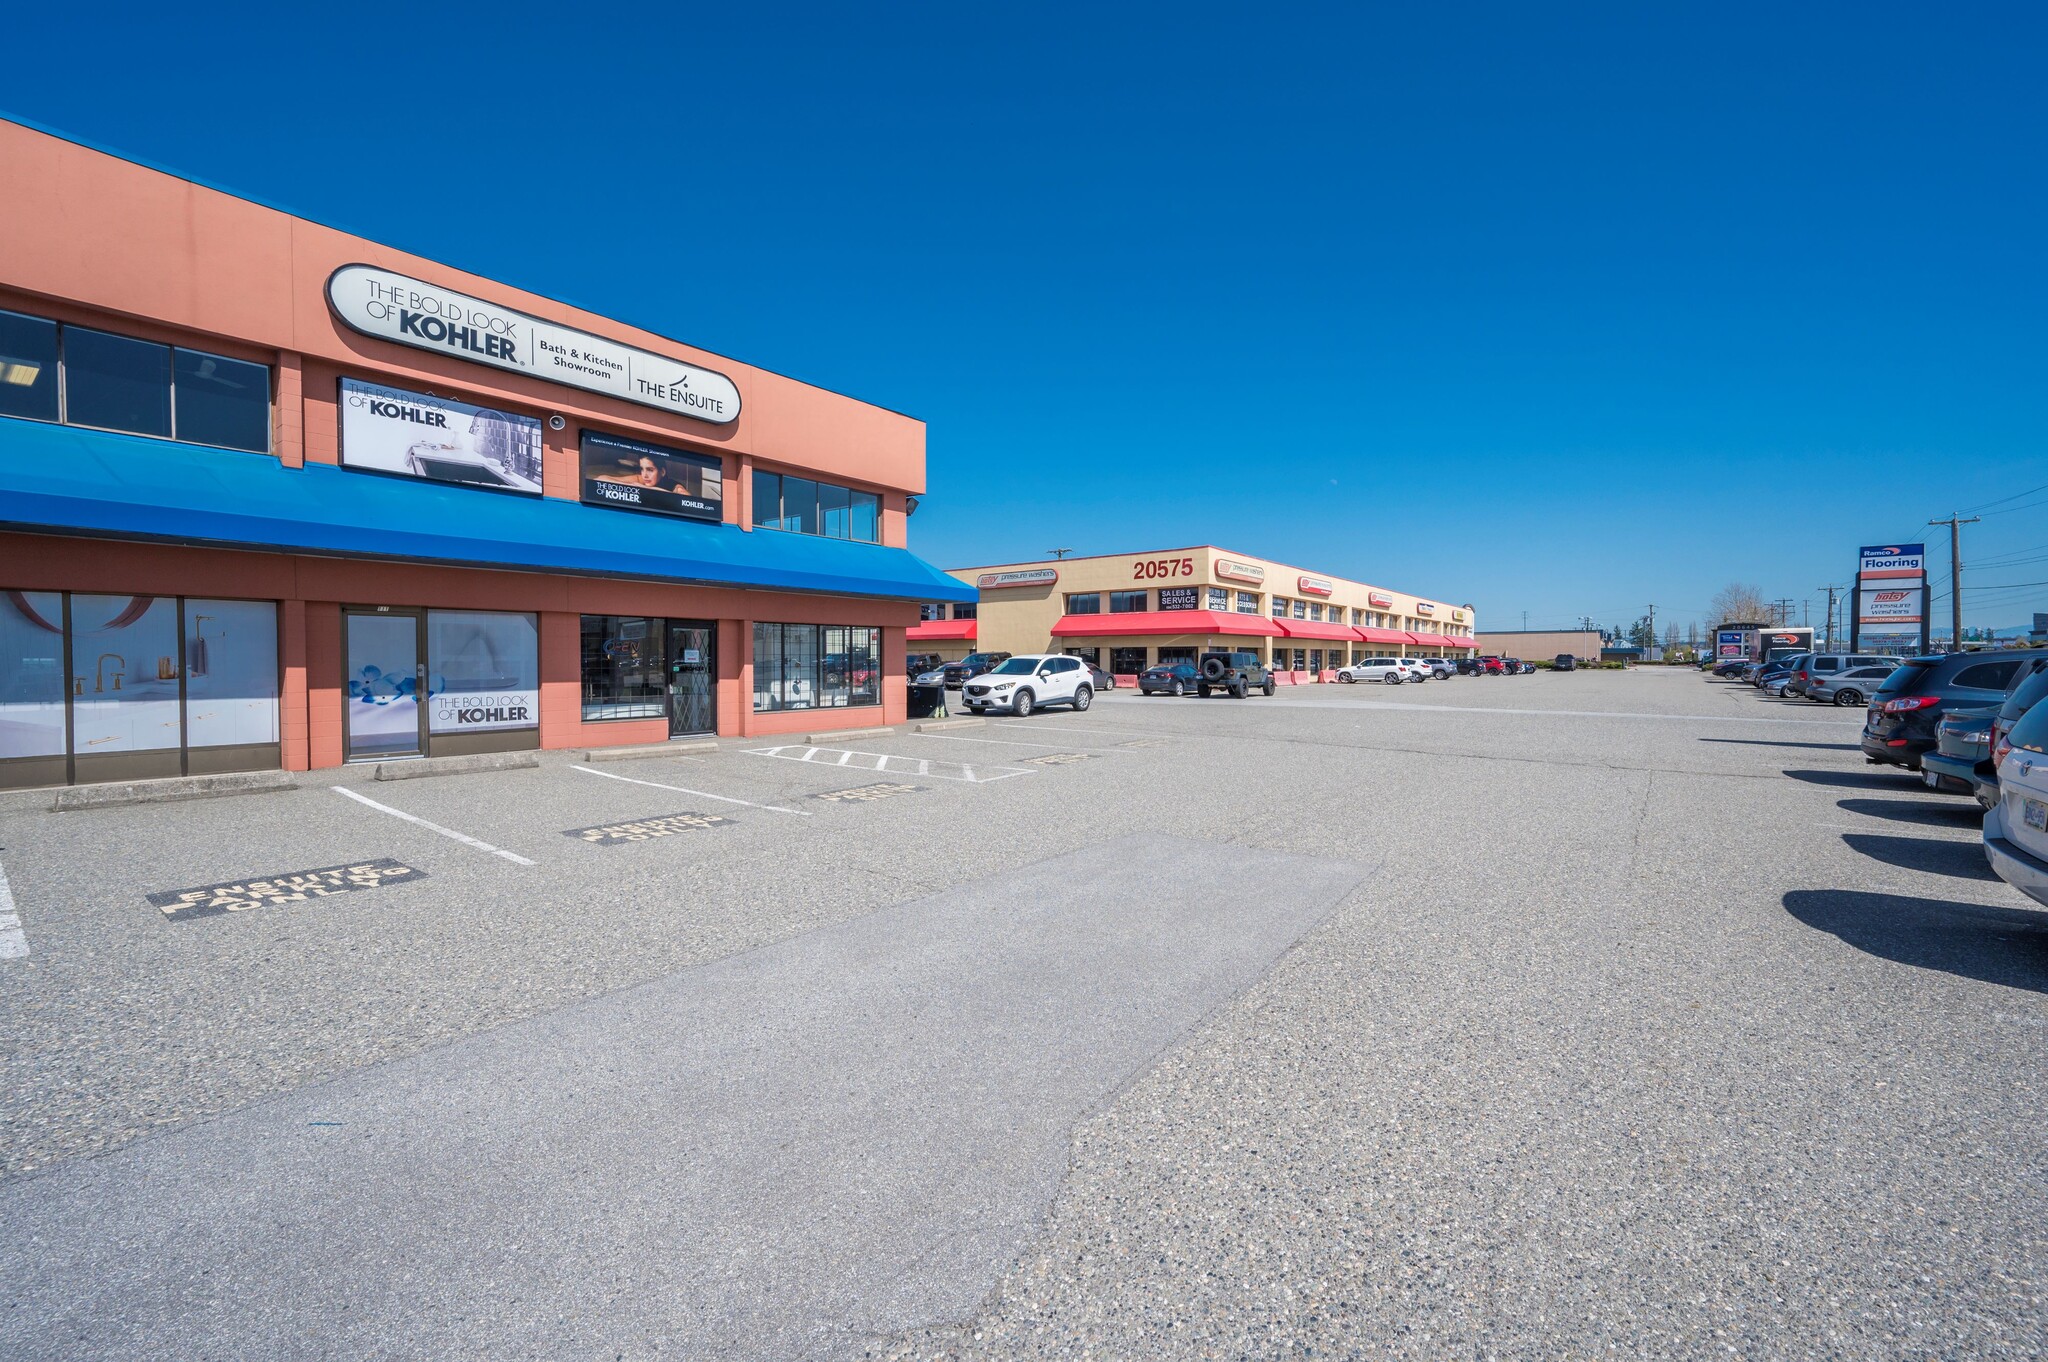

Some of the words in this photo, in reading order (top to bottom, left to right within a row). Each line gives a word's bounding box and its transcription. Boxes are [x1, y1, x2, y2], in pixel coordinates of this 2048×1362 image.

[366, 279, 404, 305] THE
[410, 291, 462, 321] BOLD
[467, 309, 517, 339] LOOK
[366, 300, 396, 321] OF
[400, 309, 518, 363] KOHLER
[540, 340, 567, 355] Bath
[570, 348, 579, 359] &
[583, 352, 623, 371] Kitchen
[554, 356, 611, 379] Showroom
[349, 383, 372, 398] THE
[376, 388, 409, 405] BOLD
[413, 397, 447, 413] LOOK
[637, 378, 665, 398] THE
[670, 387, 723, 414] ENSUITE
[349, 395, 367, 408] OF
[370, 400, 448, 429] KOHLER
[596, 482, 608, 490] THE
[608, 485, 623, 493] BOLD
[623, 487, 640, 495] LOOK
[605, 490, 640, 503] KOHLER
[681, 500, 715, 511] KOHLER.com
[1133, 558, 1194, 579] 20575
[1865, 558, 1919, 568] Flooring
[1001, 572, 1027, 581] pressure
[1028, 570, 1054, 578] washers
[1161, 589, 1184, 597] SALES
[1161, 596, 1196, 605] SERVICE
[438, 697, 460, 709] THE
[462, 696, 494, 708] BOLD
[497, 695, 529, 707] LOOK
[438, 709, 456, 721] OF
[457, 706, 529, 724] KOHLER
[159, 867, 412, 914] PARKING
[178, 864, 375, 901] ENSUITE
[227, 879, 380, 911] ONLY
